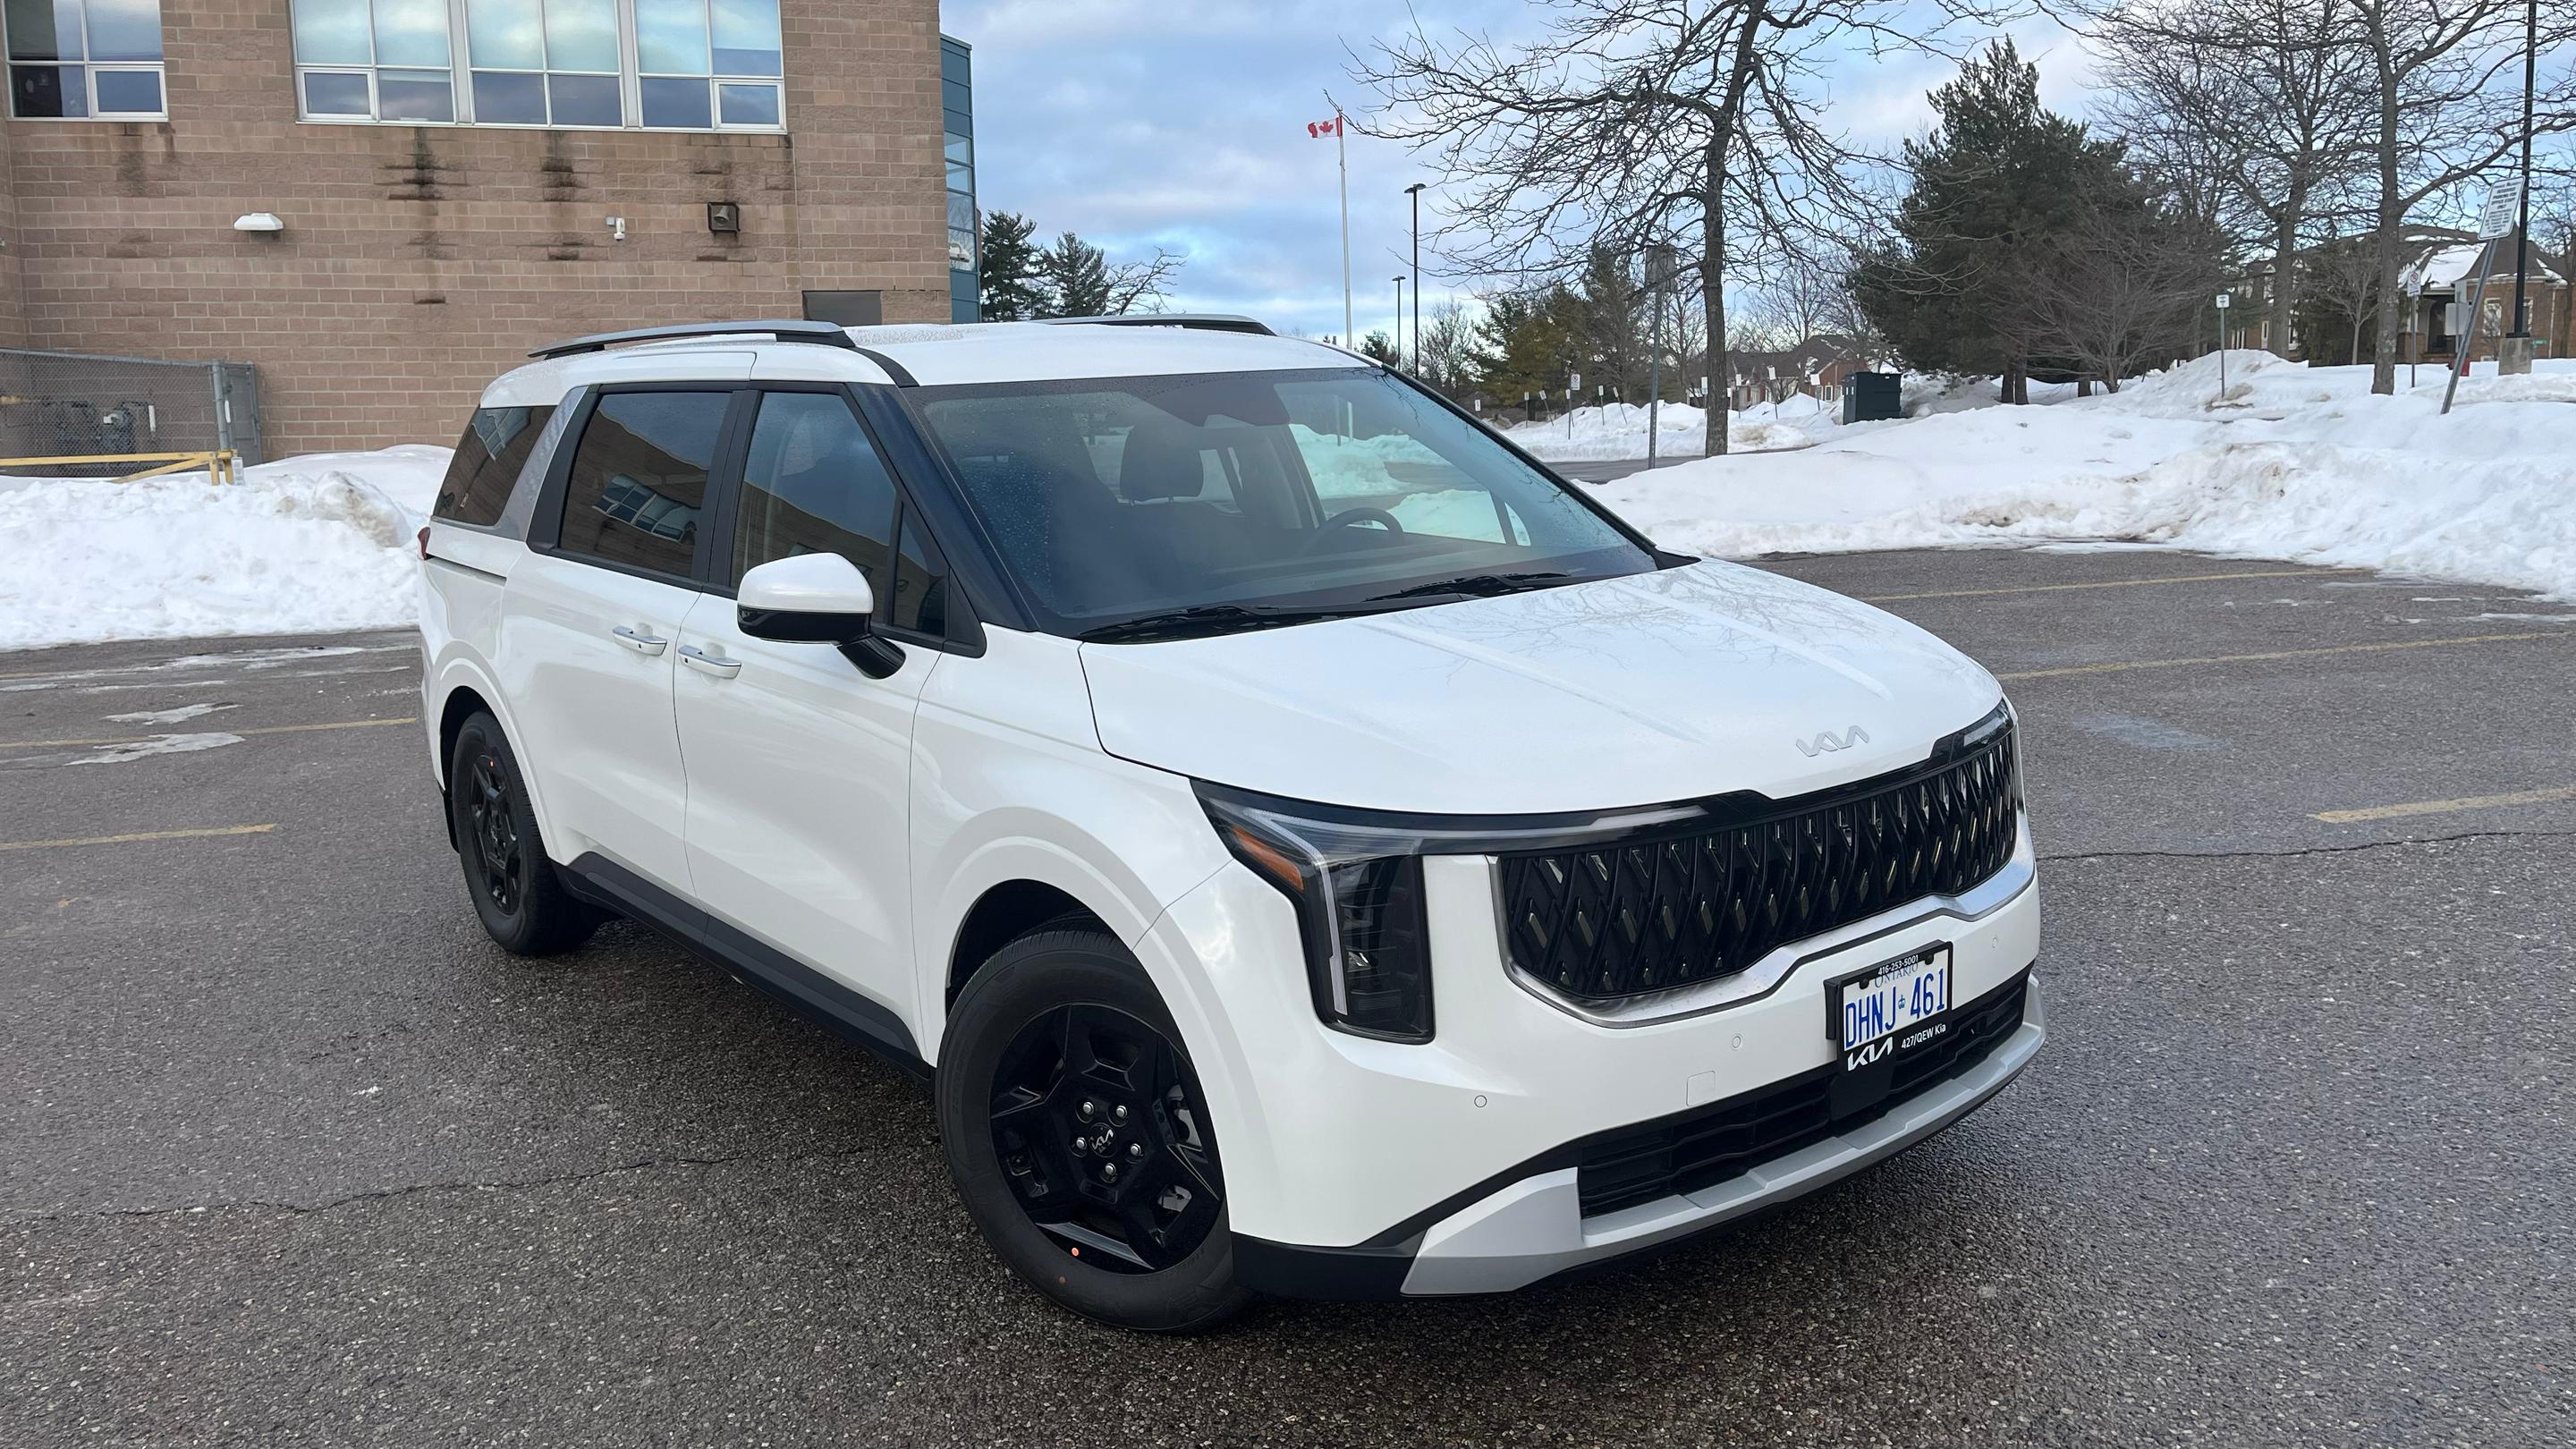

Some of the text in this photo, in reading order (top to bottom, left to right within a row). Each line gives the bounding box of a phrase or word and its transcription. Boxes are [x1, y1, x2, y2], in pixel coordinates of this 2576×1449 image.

[1796, 724, 1869, 758] KIA
[1875, 962, 1919, 987] ONTARIO
[1877, 954, 1919, 976] 416-253-5001
[1845, 968, 1945, 1048] DHNJ 461
[1901, 1022, 1946, 1049] 427/QEW Kia
[1847, 1036, 1893, 1072] KIA
